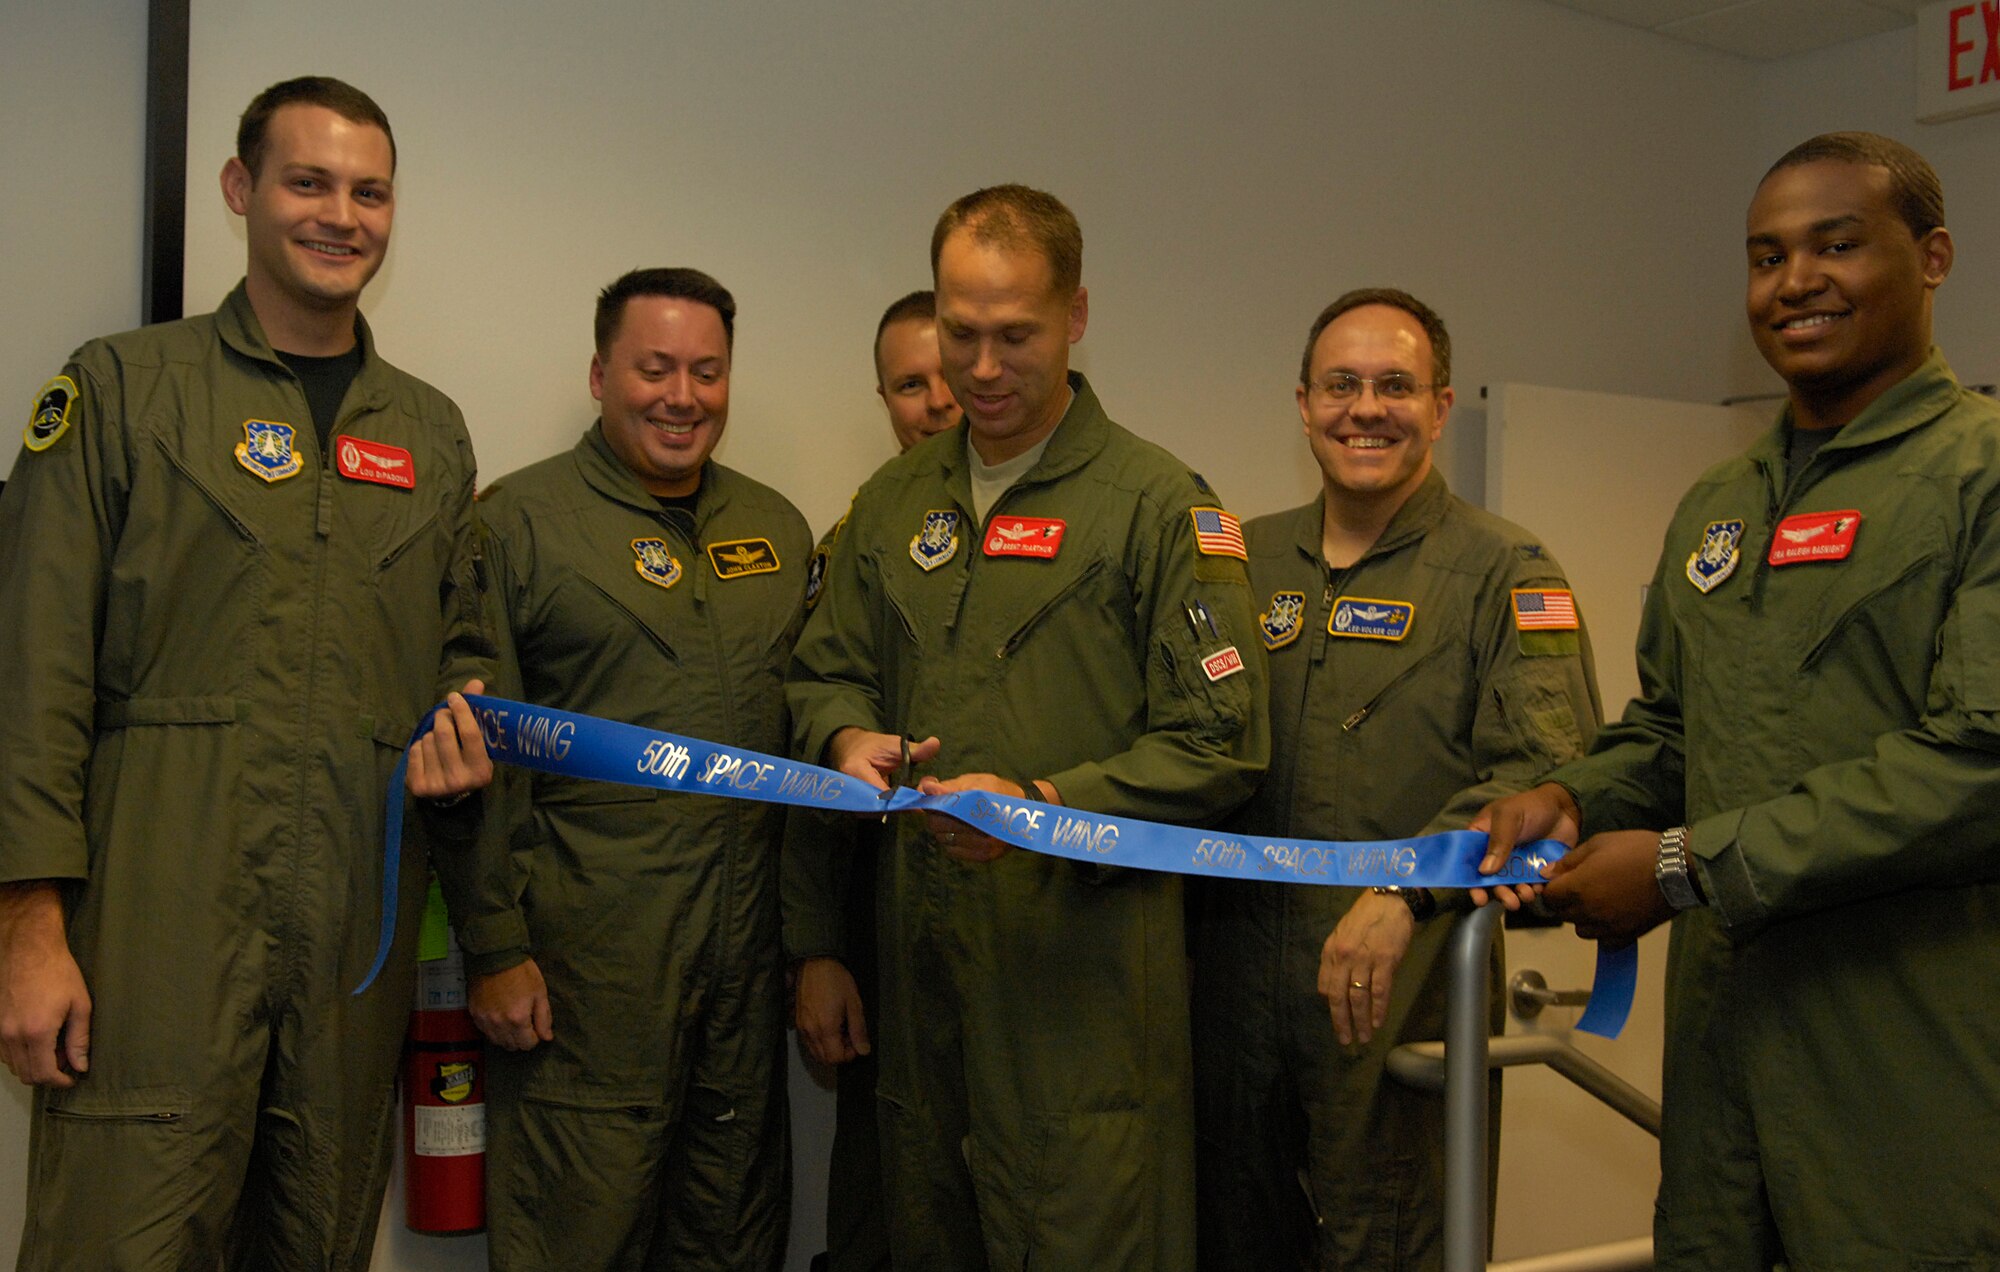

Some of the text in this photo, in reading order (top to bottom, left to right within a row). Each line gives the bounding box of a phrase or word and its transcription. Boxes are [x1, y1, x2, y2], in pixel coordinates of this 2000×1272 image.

[1948, 1, 2000, 91] EX
[360, 468, 374, 477] LOU
[726, 566, 743, 574] JOHN
[517, 713, 576, 761] WING
[637, 740, 845, 801] 50th SPACE WING
[970, 799, 1119, 853] SPACE WING
[1192, 838, 1416, 877] 50th SPACE WING
